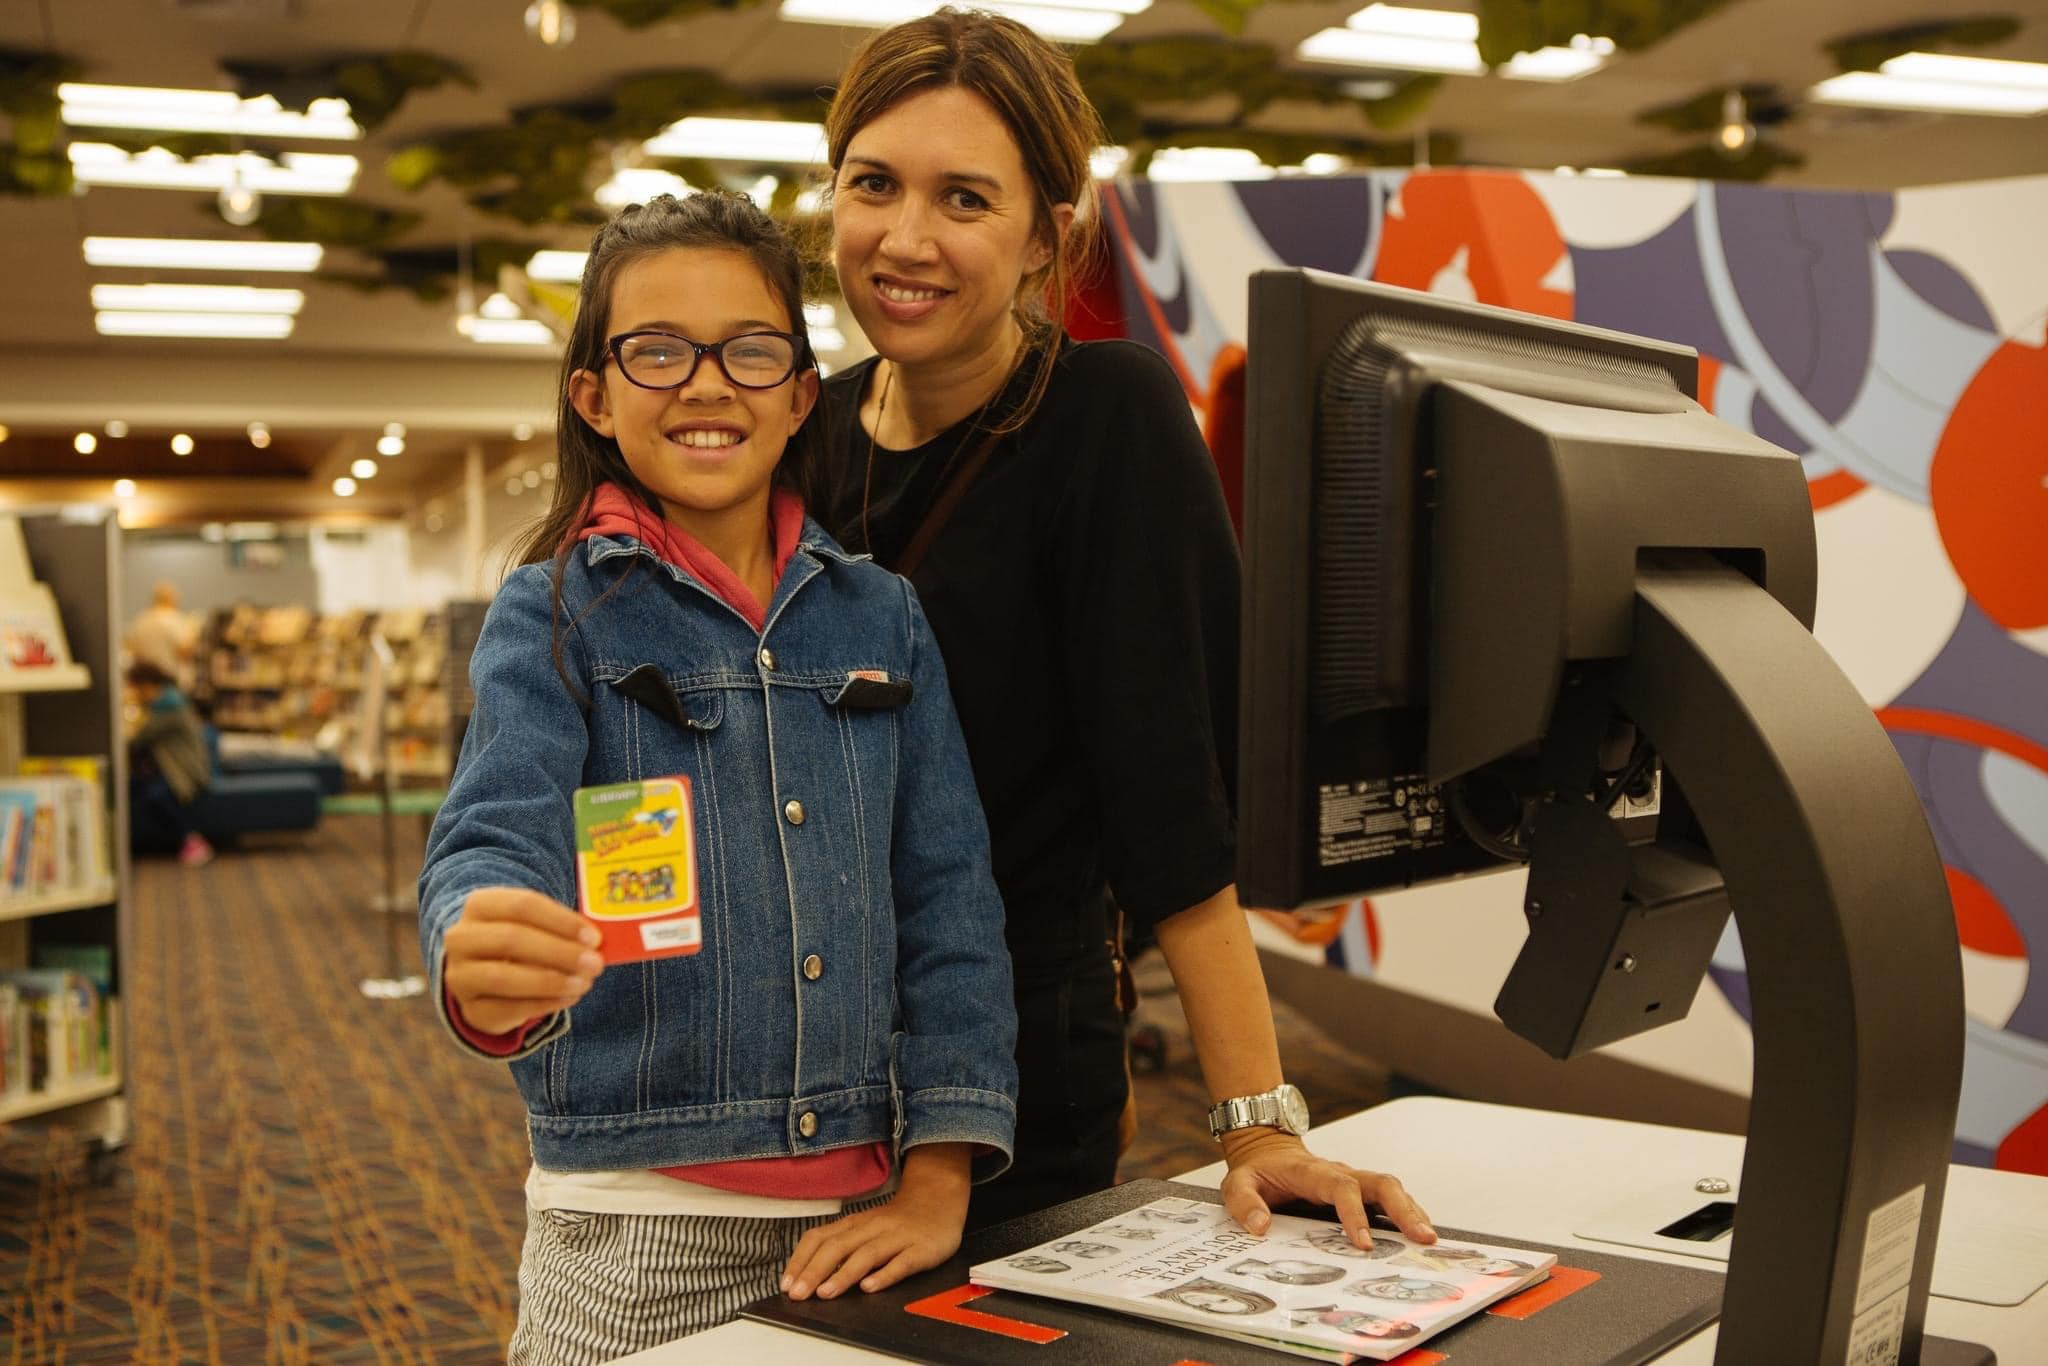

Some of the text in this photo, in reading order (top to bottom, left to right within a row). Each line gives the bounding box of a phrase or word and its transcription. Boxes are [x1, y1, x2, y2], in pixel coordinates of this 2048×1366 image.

[1202, 1229, 1251, 1249] YOU
[1152, 1238, 1269, 1282] THE PEOPLE
[1156, 1246, 1209, 1267] MAY
[1118, 1265, 1161, 1281] SEE
